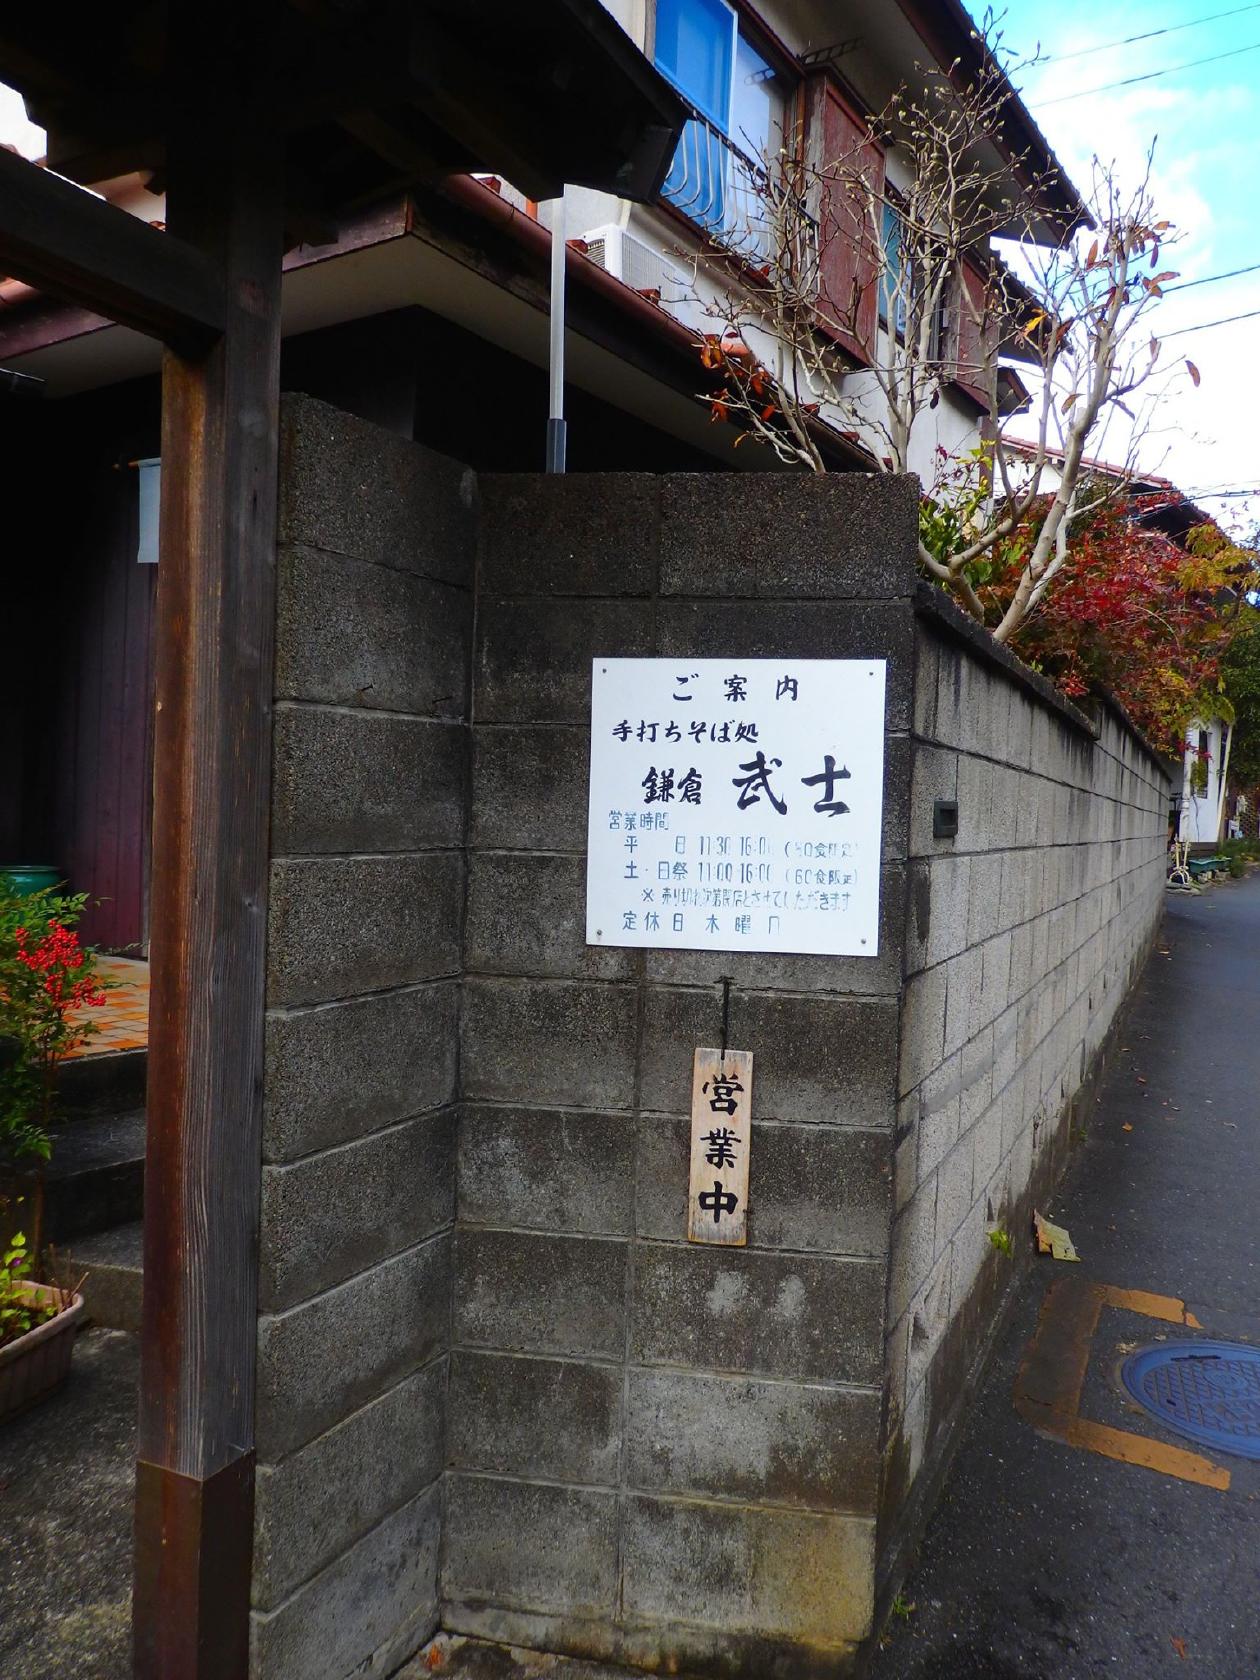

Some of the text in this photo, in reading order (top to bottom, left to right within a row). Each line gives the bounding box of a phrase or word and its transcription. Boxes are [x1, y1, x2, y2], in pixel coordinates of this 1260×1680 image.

[672, 673, 799, 702] ご案内
[612, 719, 760, 744] 手打ちそば処
[641, 750, 852, 818] 鎌倉 武士
[608, 810, 670, 831] 営業時間
[622, 910, 685, 933] 定休日
[697, 1072, 745, 1224] 営業中
